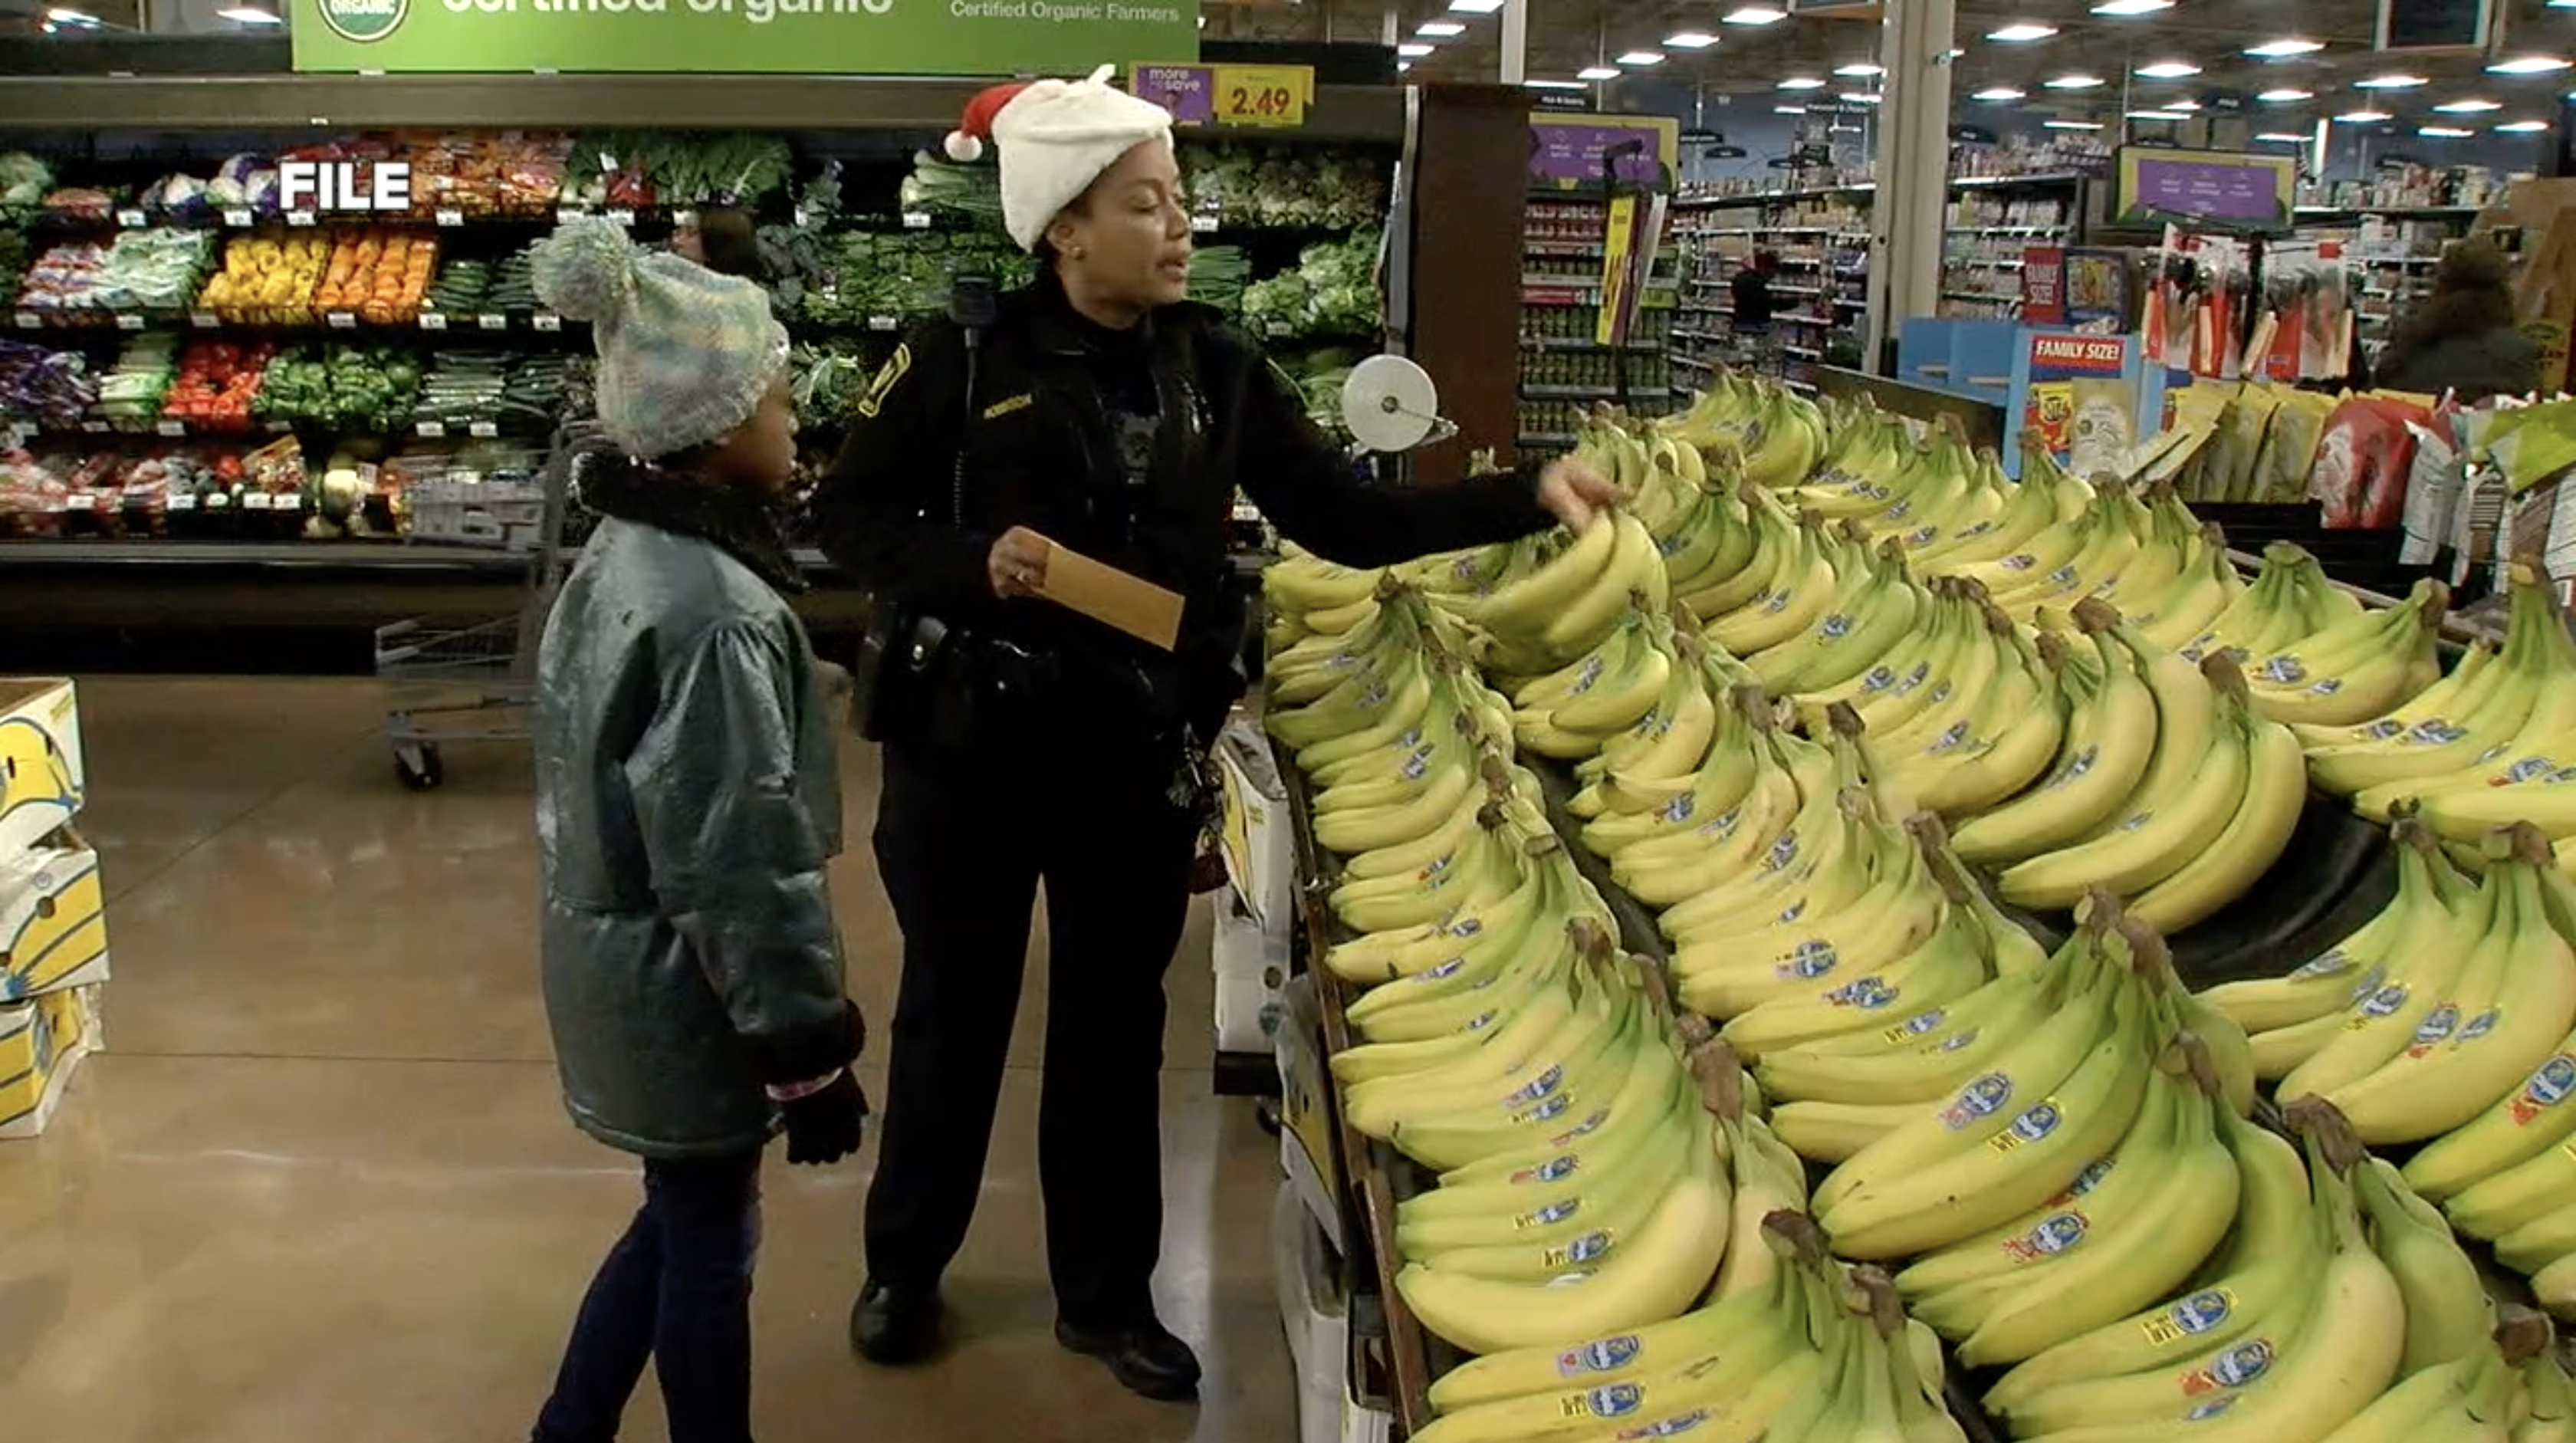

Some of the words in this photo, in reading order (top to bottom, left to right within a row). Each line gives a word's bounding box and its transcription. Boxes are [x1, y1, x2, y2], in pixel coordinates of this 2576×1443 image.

[950, 1, 1026, 17] Certified
[1031, 2, 1102, 22] Organic
[1106, 4, 1180, 22] Farmers
[1231, 87, 1290, 116] 2.49
[2036, 340, 2086, 358] FAMILY
